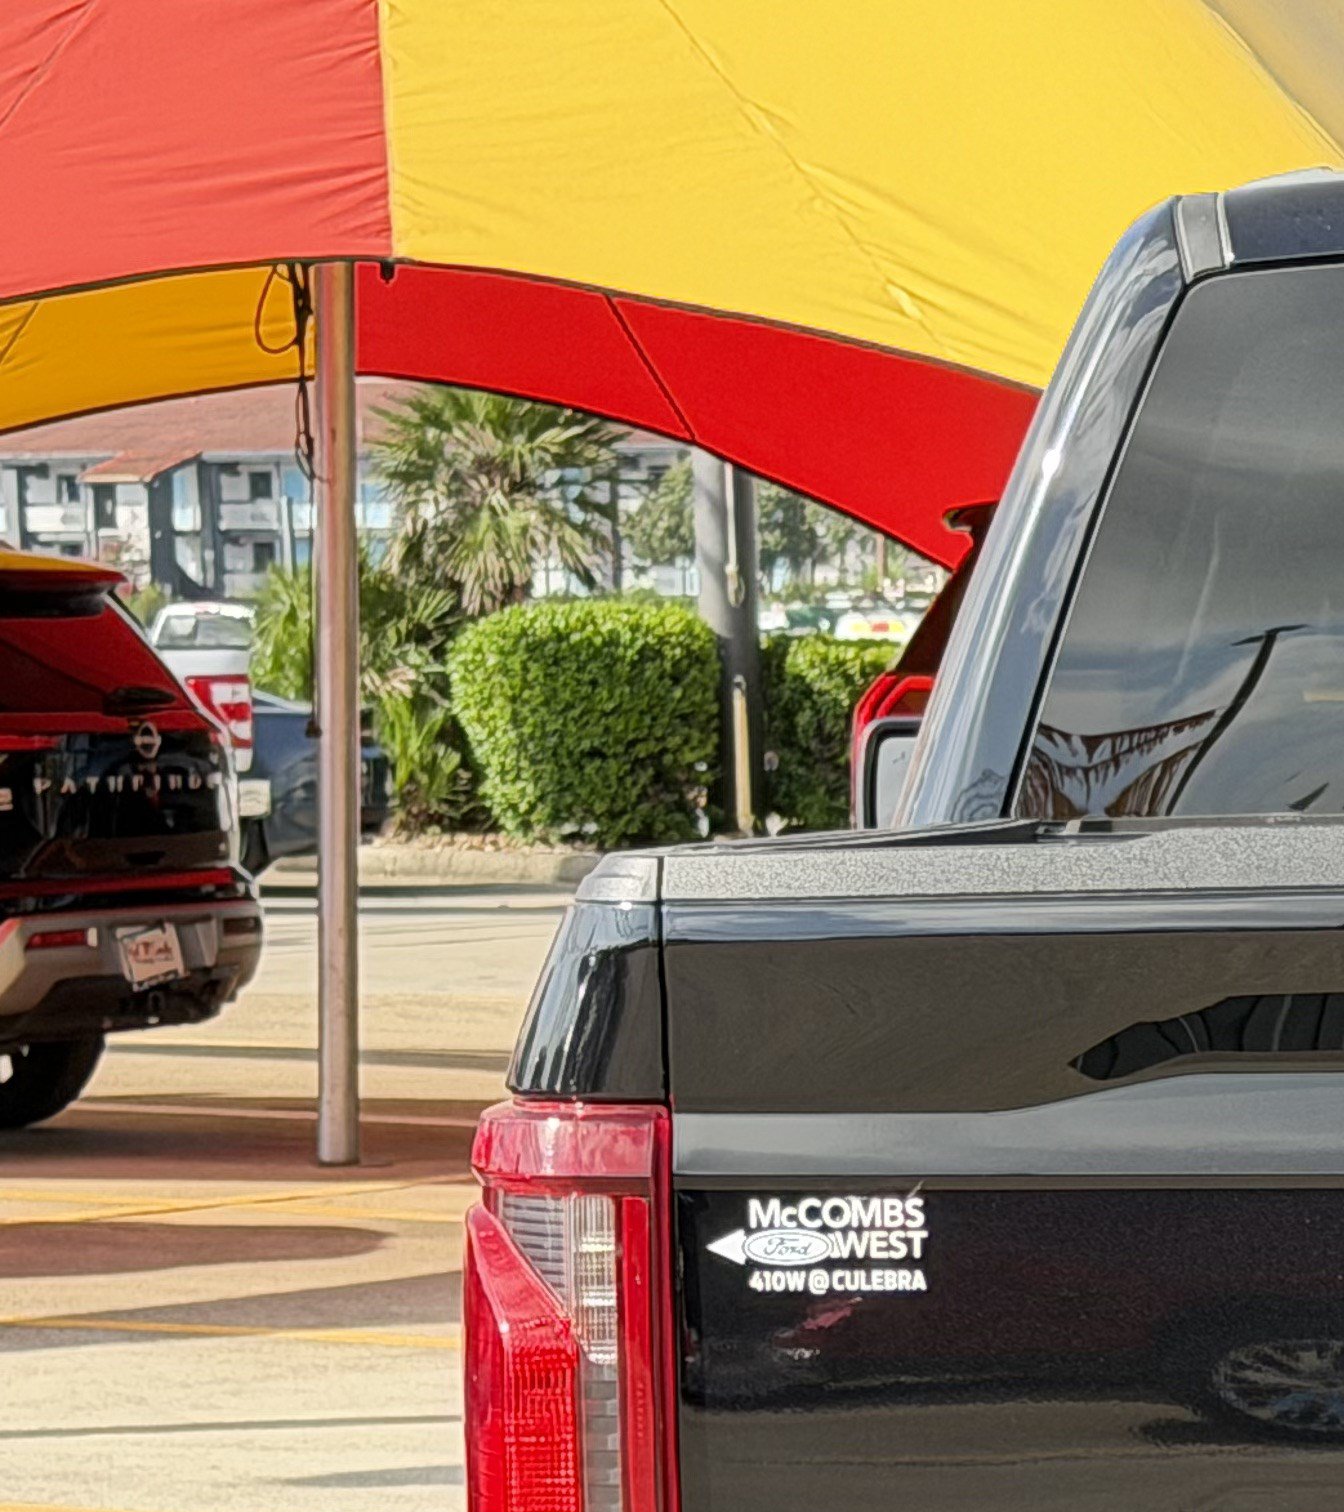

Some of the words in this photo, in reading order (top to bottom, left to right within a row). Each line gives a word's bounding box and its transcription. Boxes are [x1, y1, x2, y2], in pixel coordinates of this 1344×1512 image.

[747, 1196, 926, 1230] McCOMBS
[762, 1236, 812, 1257] Ford
[836, 1229, 929, 1260] WEST
